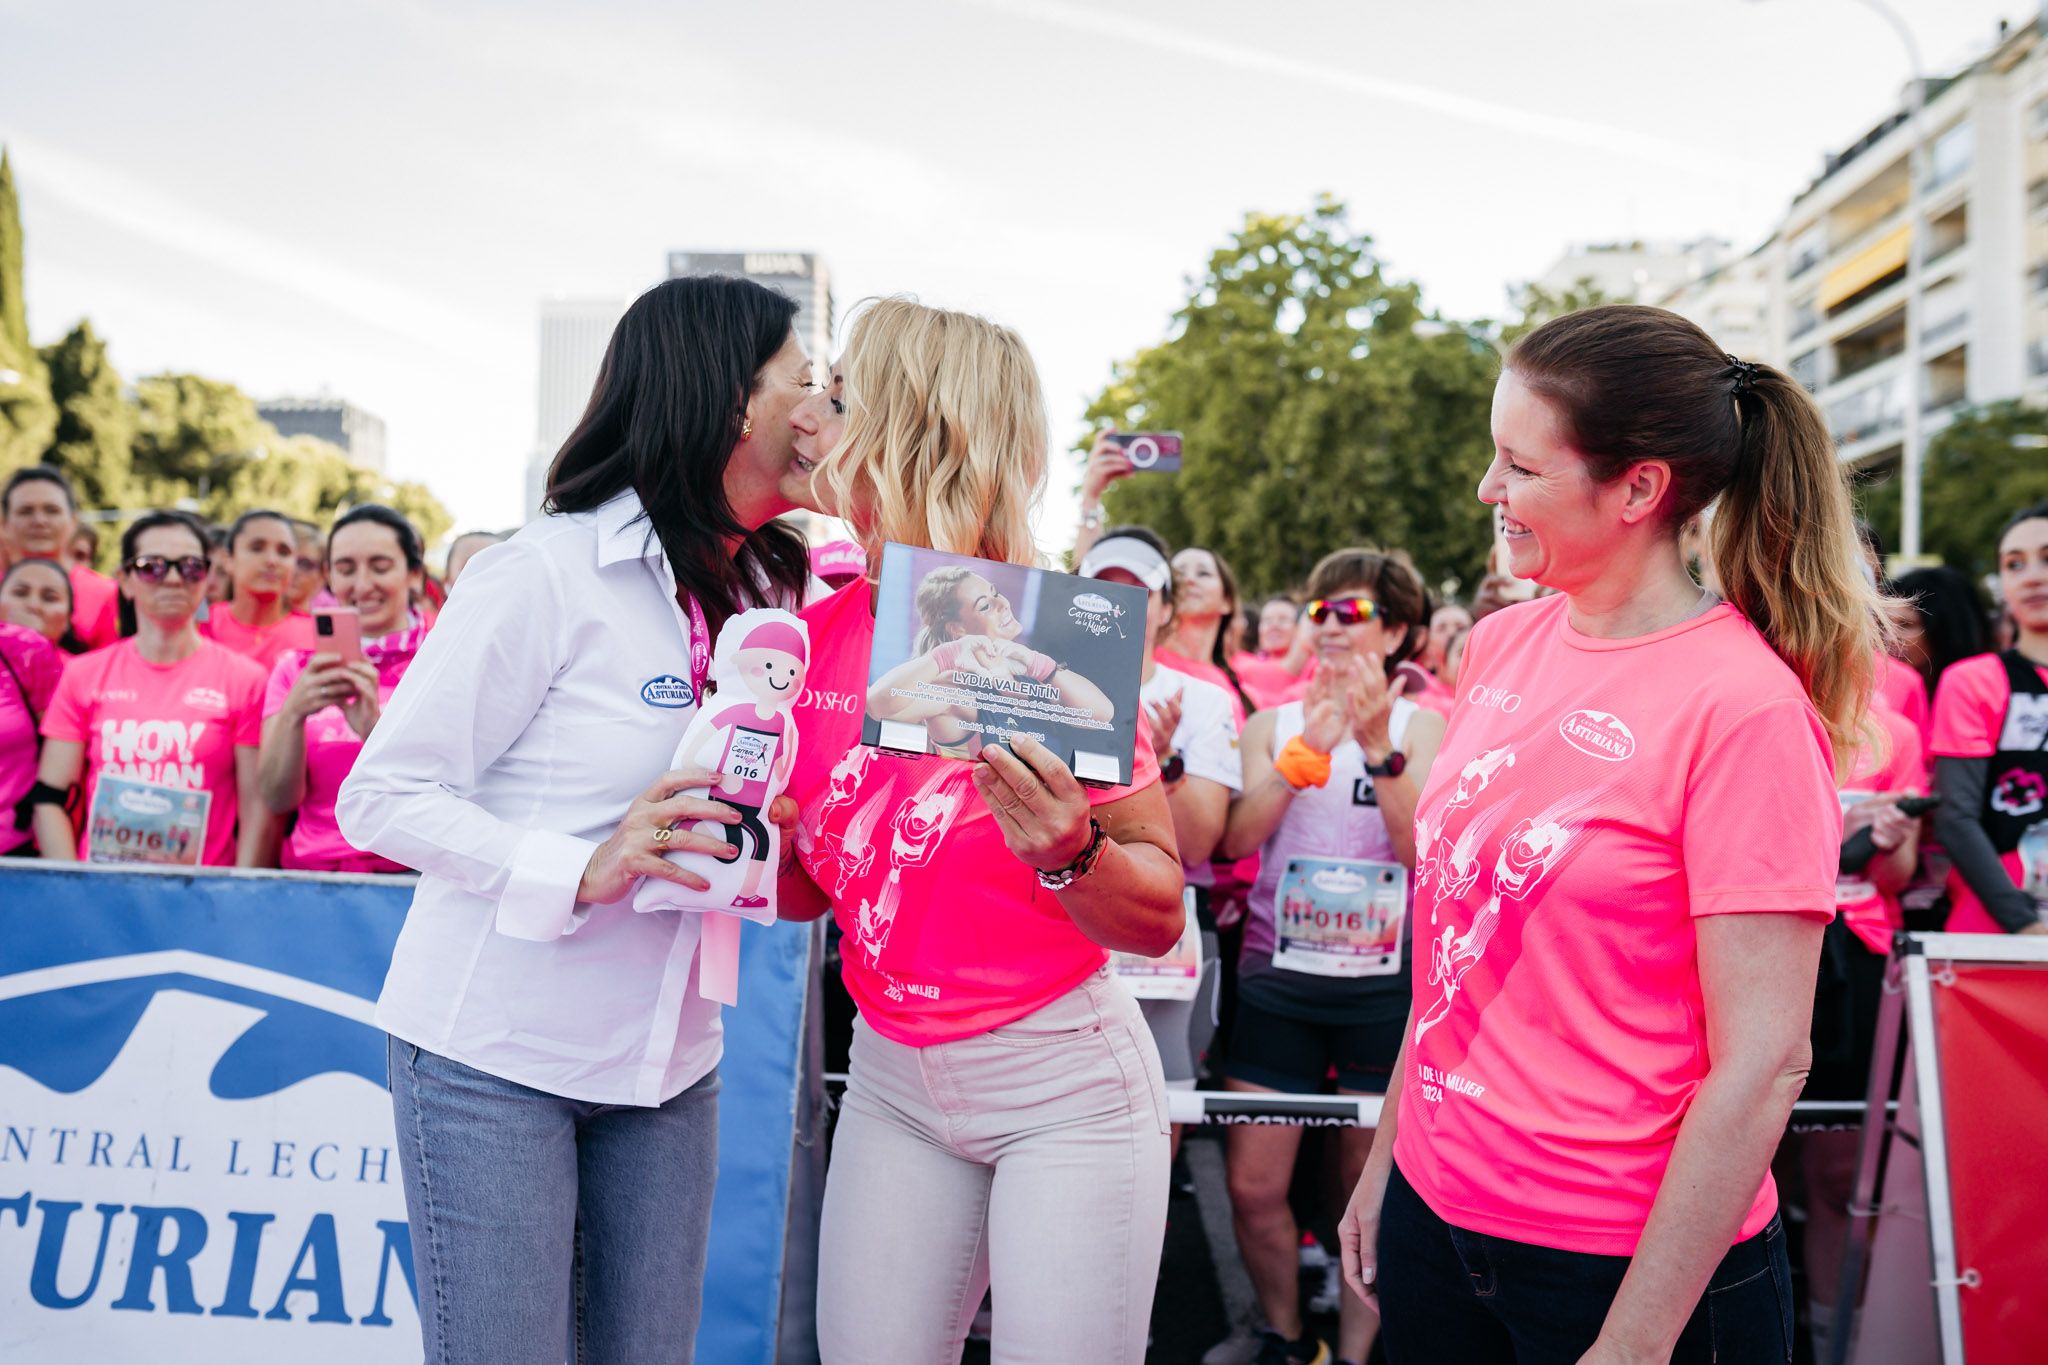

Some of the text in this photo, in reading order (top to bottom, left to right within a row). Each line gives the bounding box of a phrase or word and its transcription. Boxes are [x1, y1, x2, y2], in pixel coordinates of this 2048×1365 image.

[1068, 606, 1101, 621] Carrera
[1085, 620, 1111, 636] Mujer
[647, 687, 691, 700] ASTURIANA
[953, 671, 1060, 700] LYDIA VALENTÍN
[891, 688, 897, 696] y
[898, 688, 935, 700] convertirte
[946, 697, 960, 705] una
[960, 698, 971, 706] de
[972, 700, 982, 709] las
[982, 702, 1011, 714] mejores
[1012, 707, 1050, 720] deportistas
[1050, 713, 1061, 722] de
[1061, 716, 1088, 727] nuestra
[917, 681, 1093, 718] Por romper todas las barreras en el deporte español
[1469, 684, 1521, 713] OYSHO
[958, 720, 984, 733] Madrid,
[985, 724, 996, 734] 12
[996, 726, 1006, 736] de
[1562, 716, 1627, 757] ASTURIANA
[101, 719, 205, 763] HOY
[731, 745, 754, 755] Carrera
[733, 765, 758, 779] 016
[115, 828, 163, 850] 016
[1315, 910, 1362, 931] 016
[907, 983, 941, 1000] MUJER
[1423, 1065, 1435, 1083] DE
[1446, 1073, 1485, 1098] MUJER
